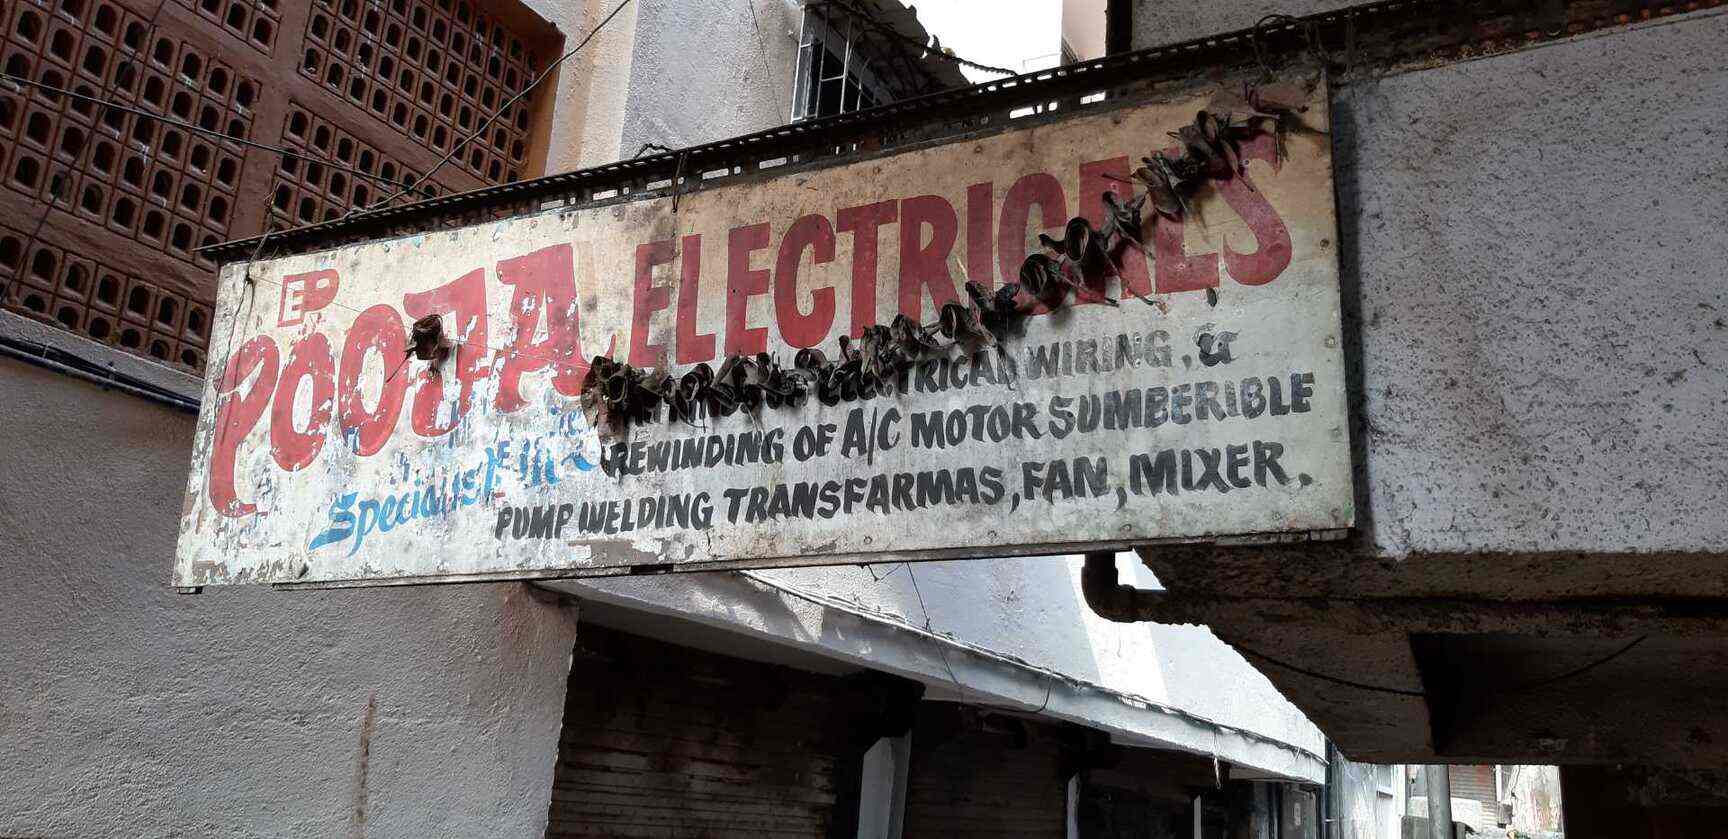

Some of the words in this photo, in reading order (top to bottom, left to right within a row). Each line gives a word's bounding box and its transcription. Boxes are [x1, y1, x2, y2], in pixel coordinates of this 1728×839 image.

[209, 243, 616, 519] POOJA
[627, 127, 1293, 369] ELECTRICALS
[606, 427, 785, 482] REWINDING
[793, 422, 837, 461] OF
[842, 406, 900, 466] A/C
[911, 402, 1046, 450] MOTOR
[1048, 371, 1316, 439] SUMBERIBLE
[494, 503, 573, 541] PUMP
[577, 490, 714, 536] WELDING
